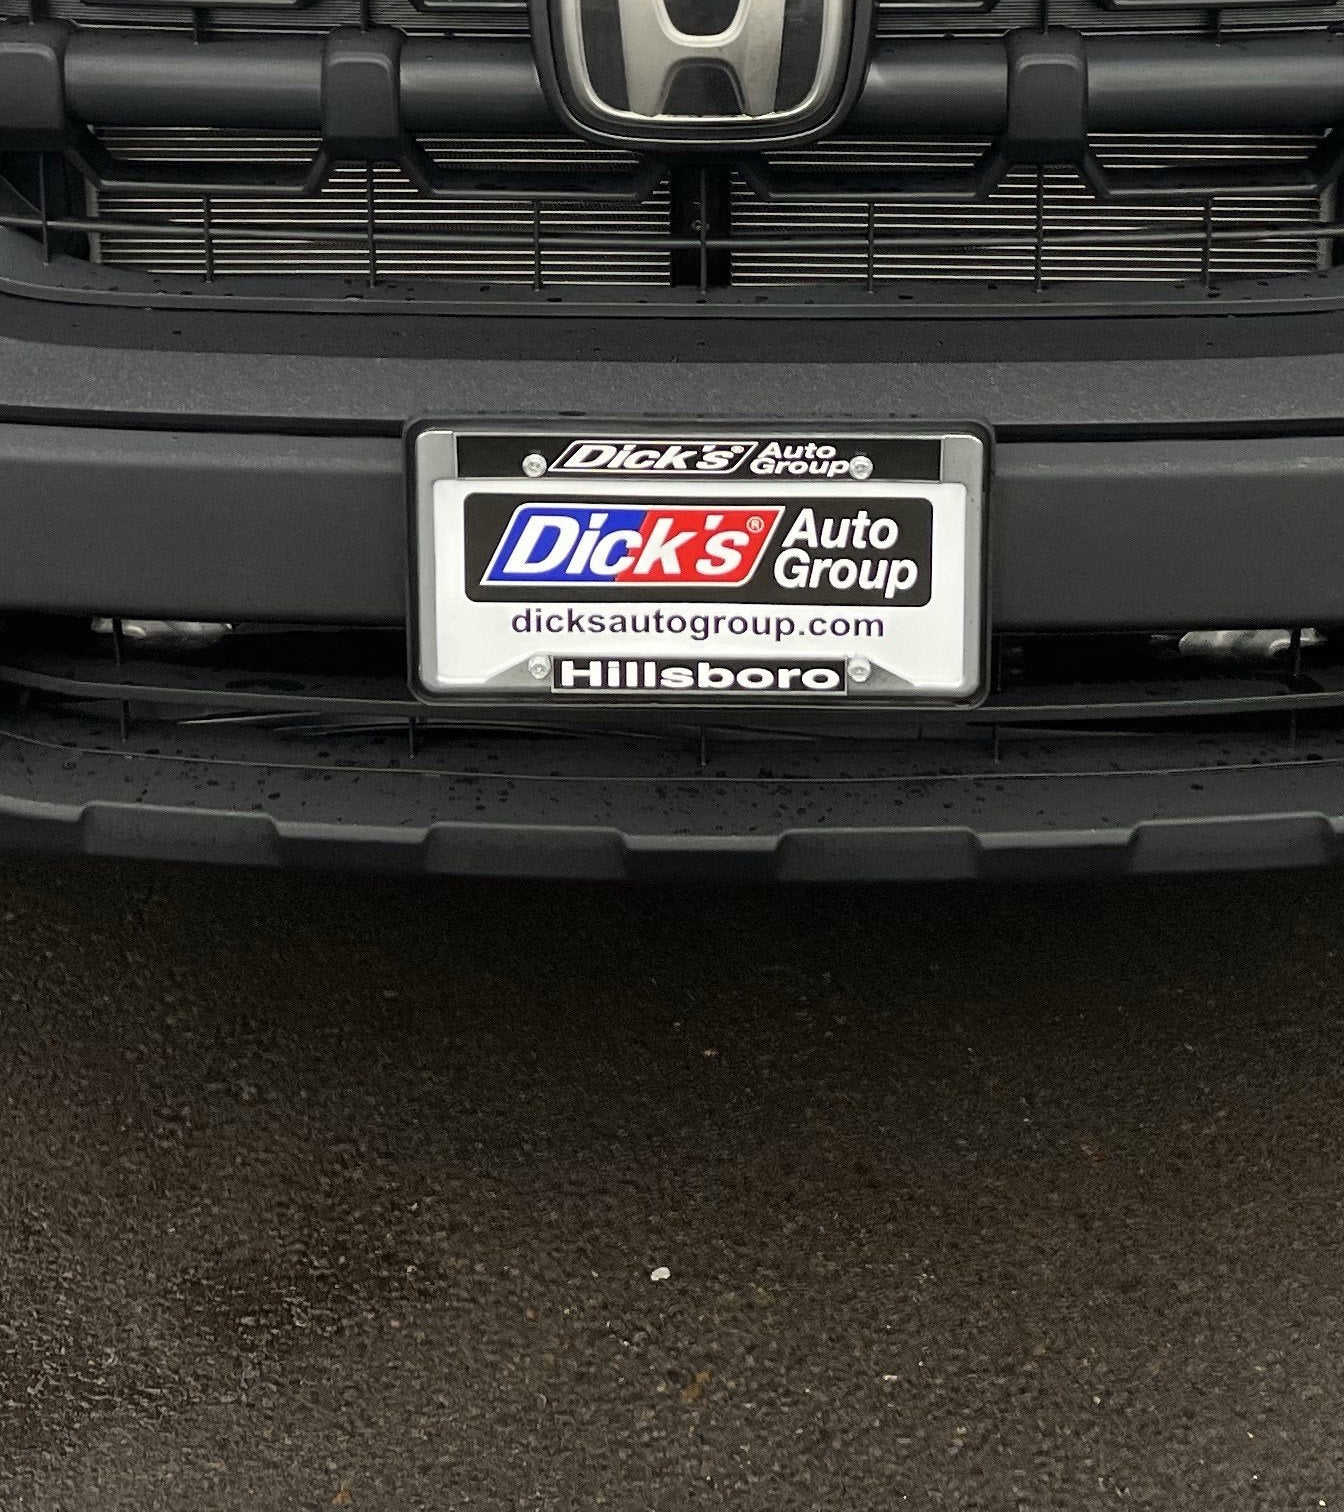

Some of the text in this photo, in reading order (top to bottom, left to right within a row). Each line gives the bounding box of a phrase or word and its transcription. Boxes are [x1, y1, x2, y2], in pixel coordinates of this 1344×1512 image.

[756, 441, 838, 459] Auto
[750, 457, 851, 478] Group
[781, 508, 899, 550] Auto
[773, 547, 919, 599] Group
[510, 607, 885, 642] dicksautogroup.com
[560, 659, 841, 690] Hillsboro
